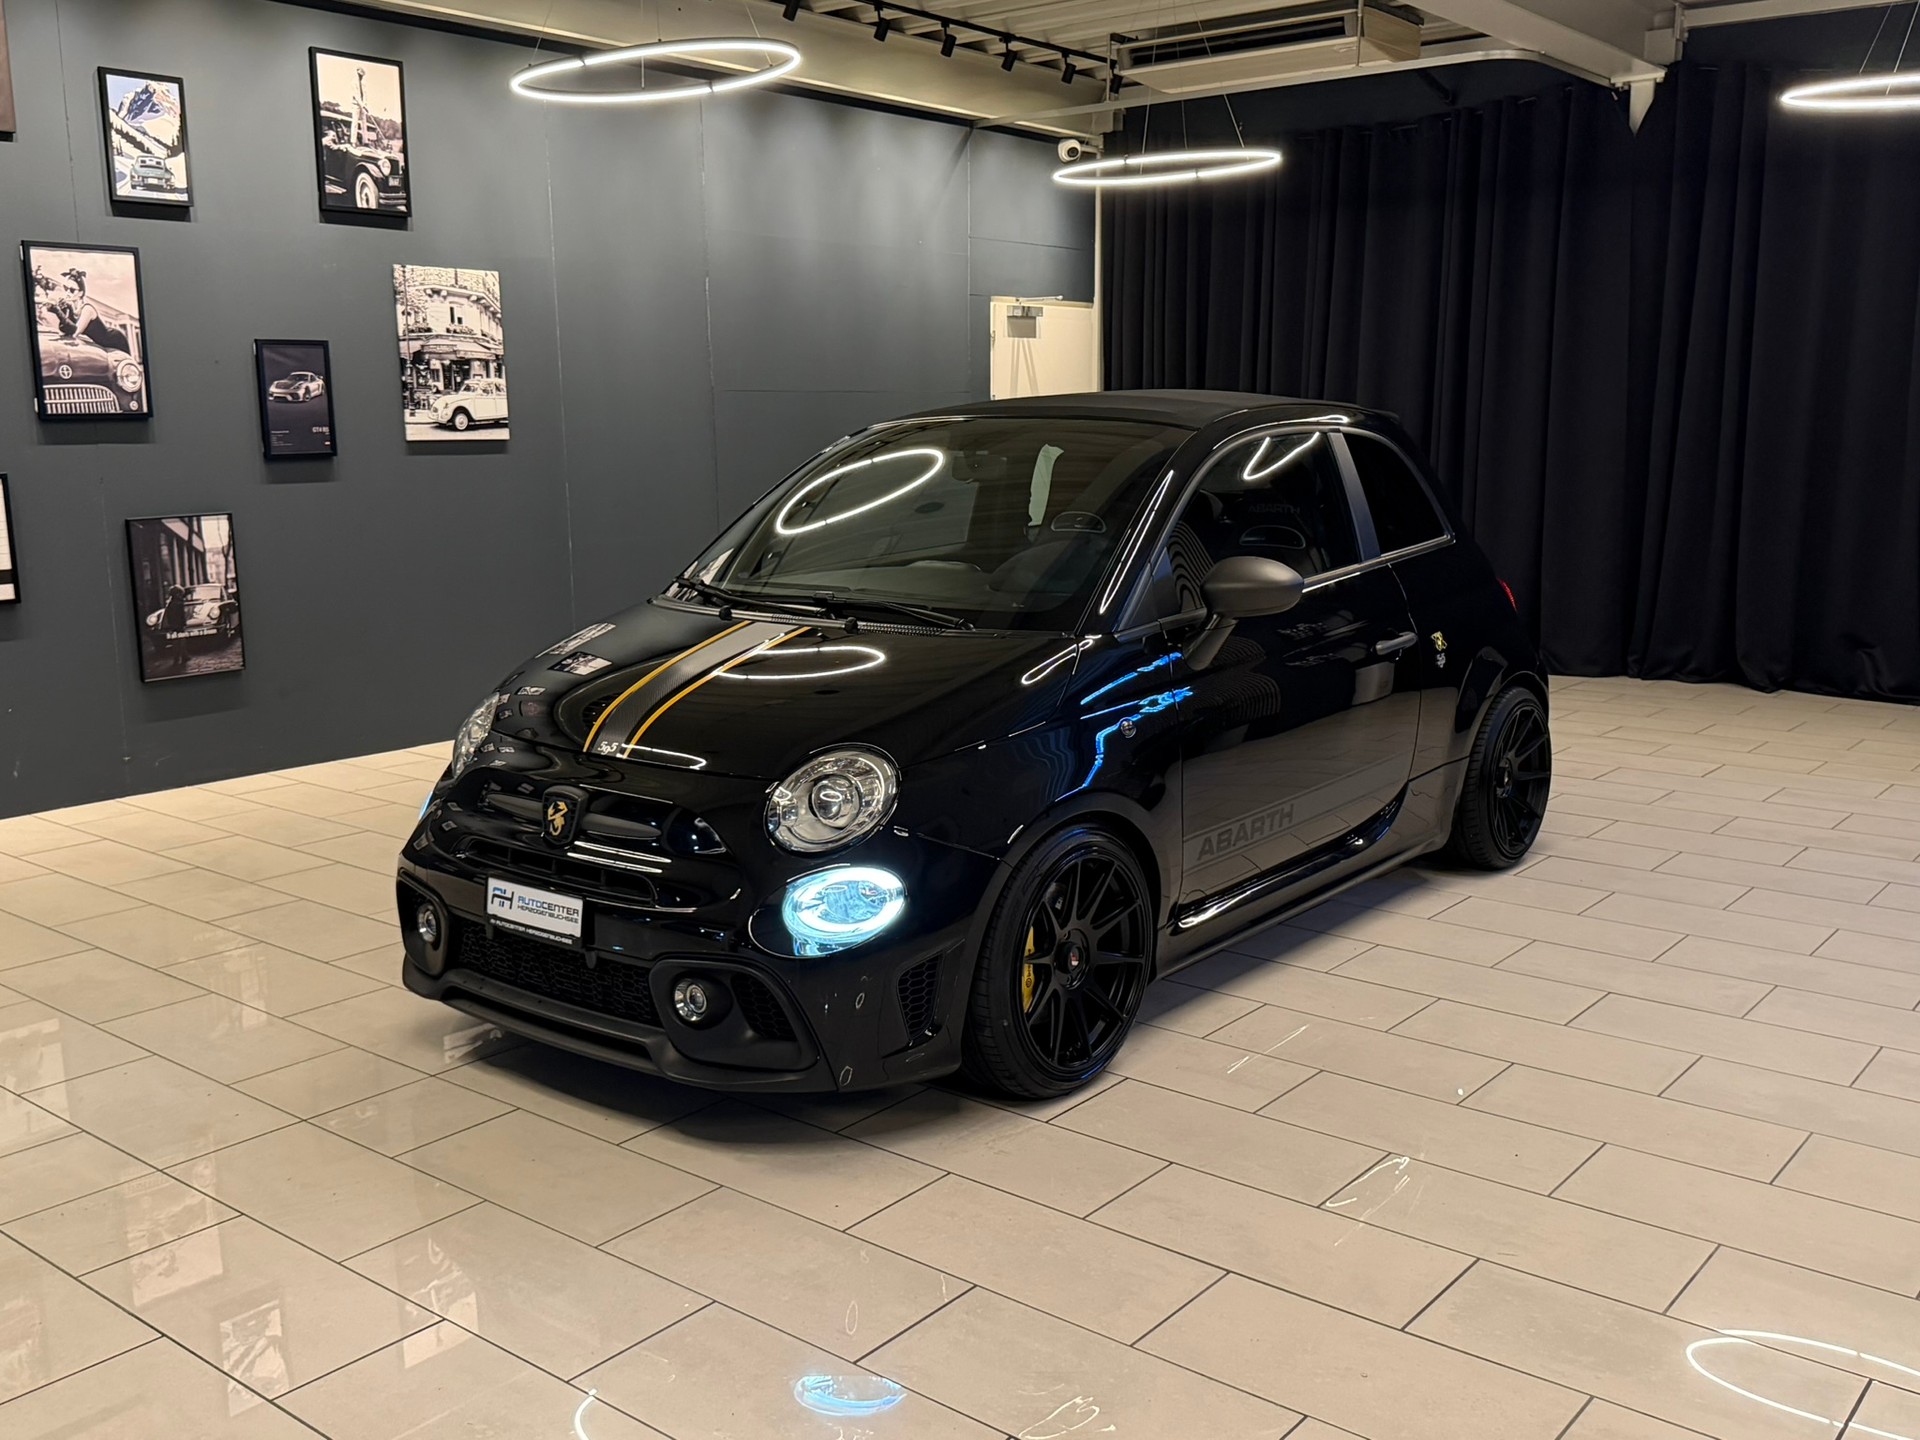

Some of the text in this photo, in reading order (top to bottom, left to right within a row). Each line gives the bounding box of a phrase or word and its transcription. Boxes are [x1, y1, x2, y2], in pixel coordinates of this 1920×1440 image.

[598, 741, 619, 755] 595
[1196, 803, 1295, 861] ABARTH
[517, 904, 579, 924] HERZOGENBUCHSEE
[518, 896, 579, 917] AUTOCENTER
